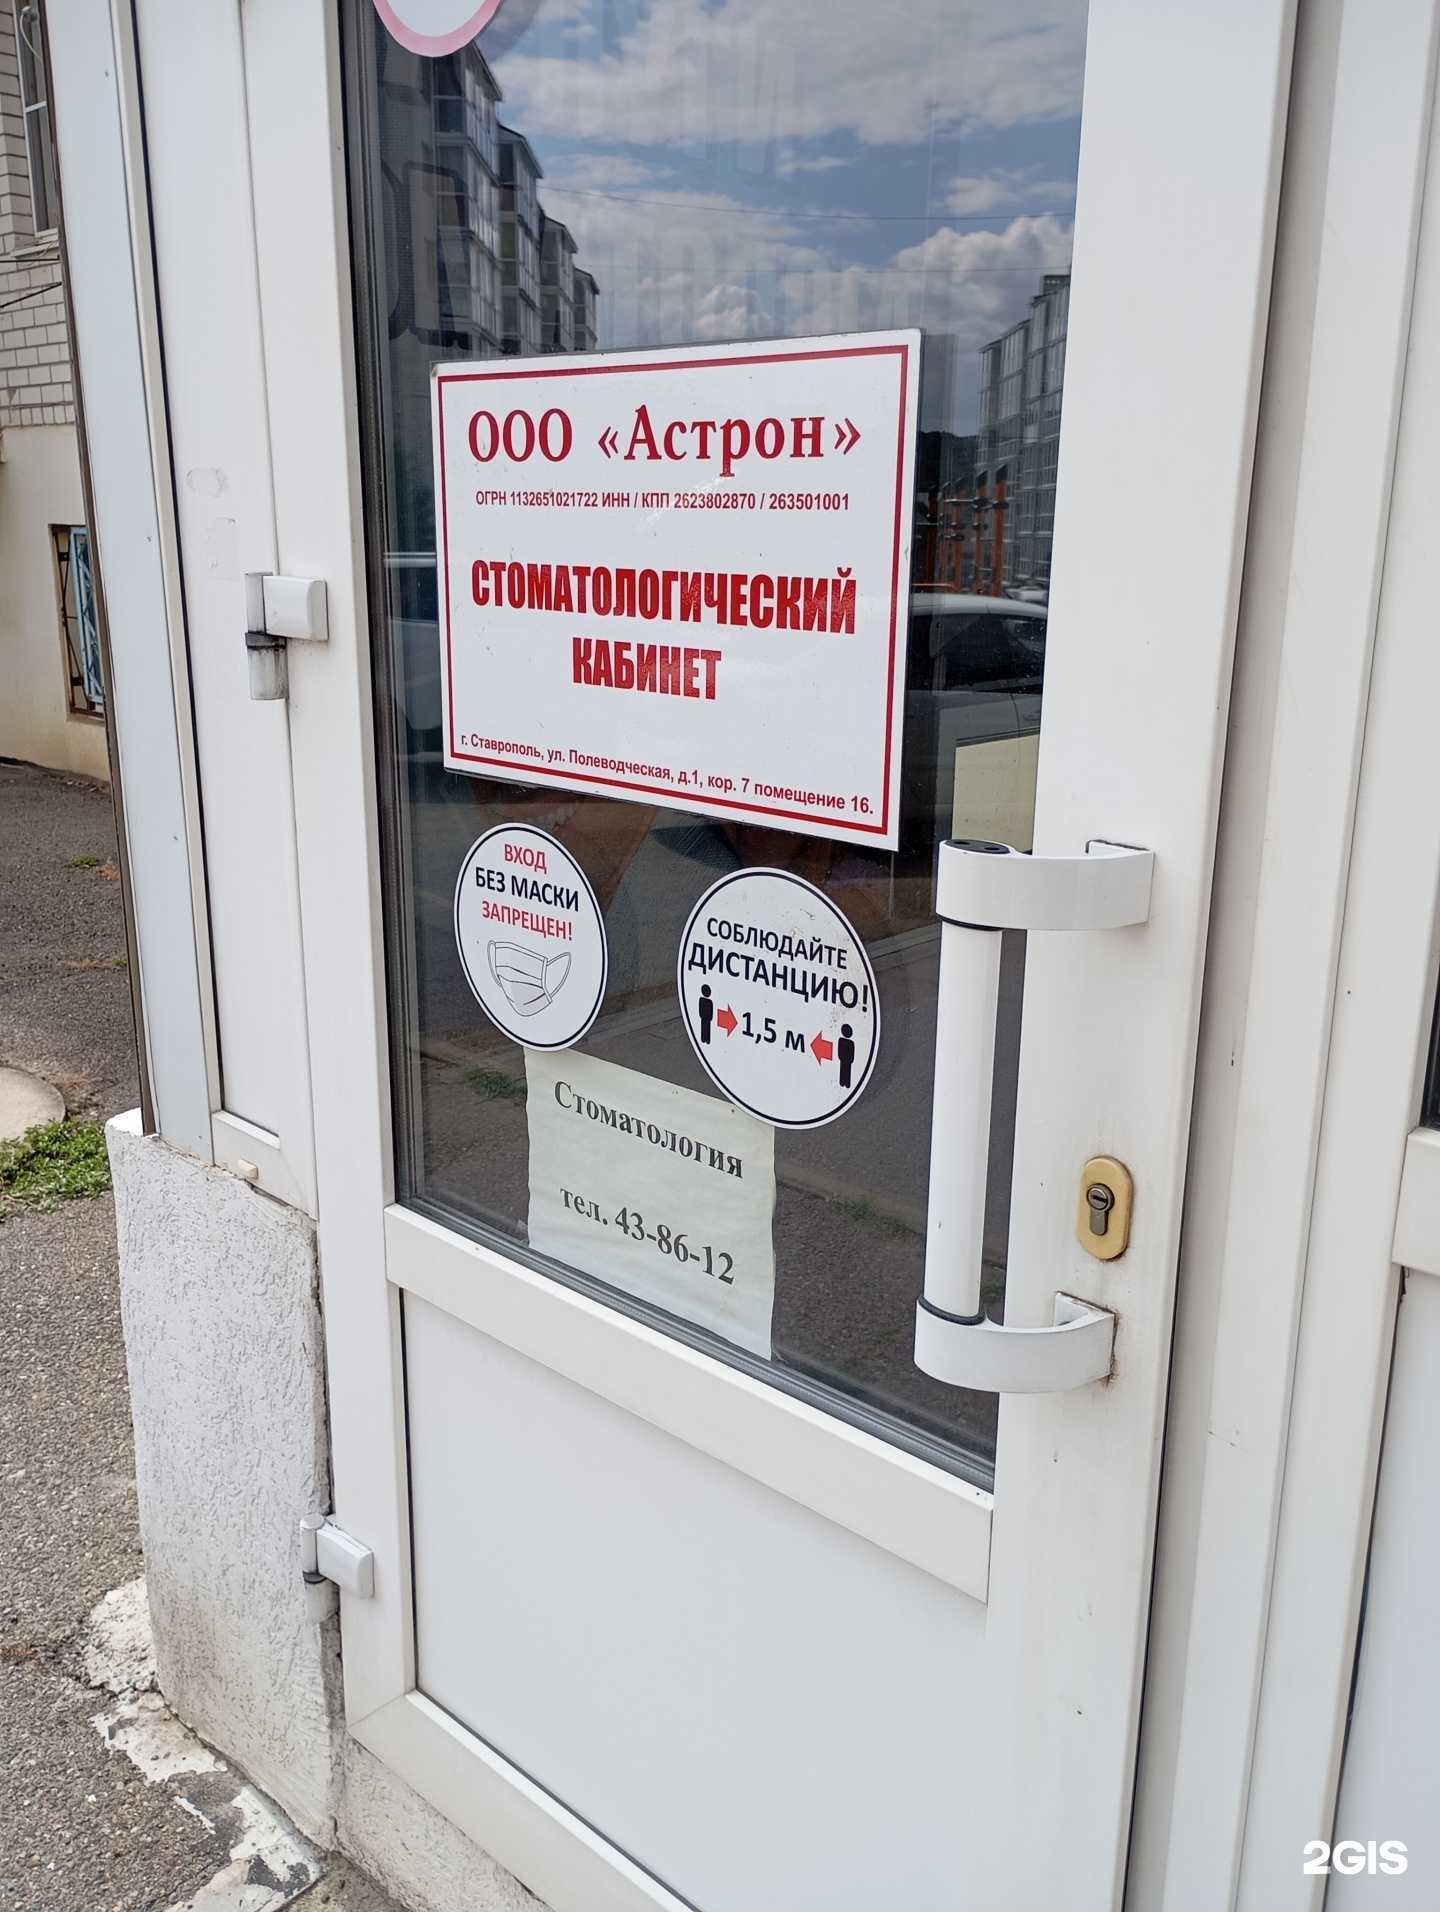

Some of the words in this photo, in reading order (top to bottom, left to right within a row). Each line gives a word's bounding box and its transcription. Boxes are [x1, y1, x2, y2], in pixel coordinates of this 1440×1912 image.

[468, 408, 573, 463] ООО
[597, 404, 862, 477] «Астрон»
[475, 490, 507, 506] ОГРН
[510, 491, 599, 508] 1132651021722
[602, 492, 631, 508] ИНН
[633, 492, 639, 509] /
[642, 492, 670, 509] КПП
[674, 492, 756, 510] 2623802870
[760, 493, 765, 510] /
[769, 493, 849, 511] 263501001
[472, 559, 857, 635] СТОМАТОЛОГИЧЕСКИЙ
[572, 637, 722, 700] КАБИНЕТ
[461, 734, 468, 746] г.
[471, 733, 545, 761] Ставрополь,
[547, 748, 566, 763] ул.
[569, 749, 675, 783] Полеводческая,
[678, 770, 703, 788] д.1,
[707, 775, 737, 794] кор.
[741, 777, 750, 793] 7
[754, 783, 846, 810] помещение
[850, 795, 874, 815] 16.
[475, 866, 506, 893] БЕЗ
[511, 876, 579, 912] МАСКИ
[504, 843, 548, 874] ВХОД
[481, 900, 573, 941] ЗАПРЕЩЕН!
[706, 917, 848, 970] СОБЛЮДАЙТЕ
[688, 942, 870, 1013] ДИСТАНЦИЮ!
[741, 1011, 778, 1046] 1,5
[785, 1030, 806, 1054] м
[554, 1080, 743, 1179] Стоматология
[560, 1188, 608, 1226] тел.
[614, 1207, 736, 1286] 43-86-12
